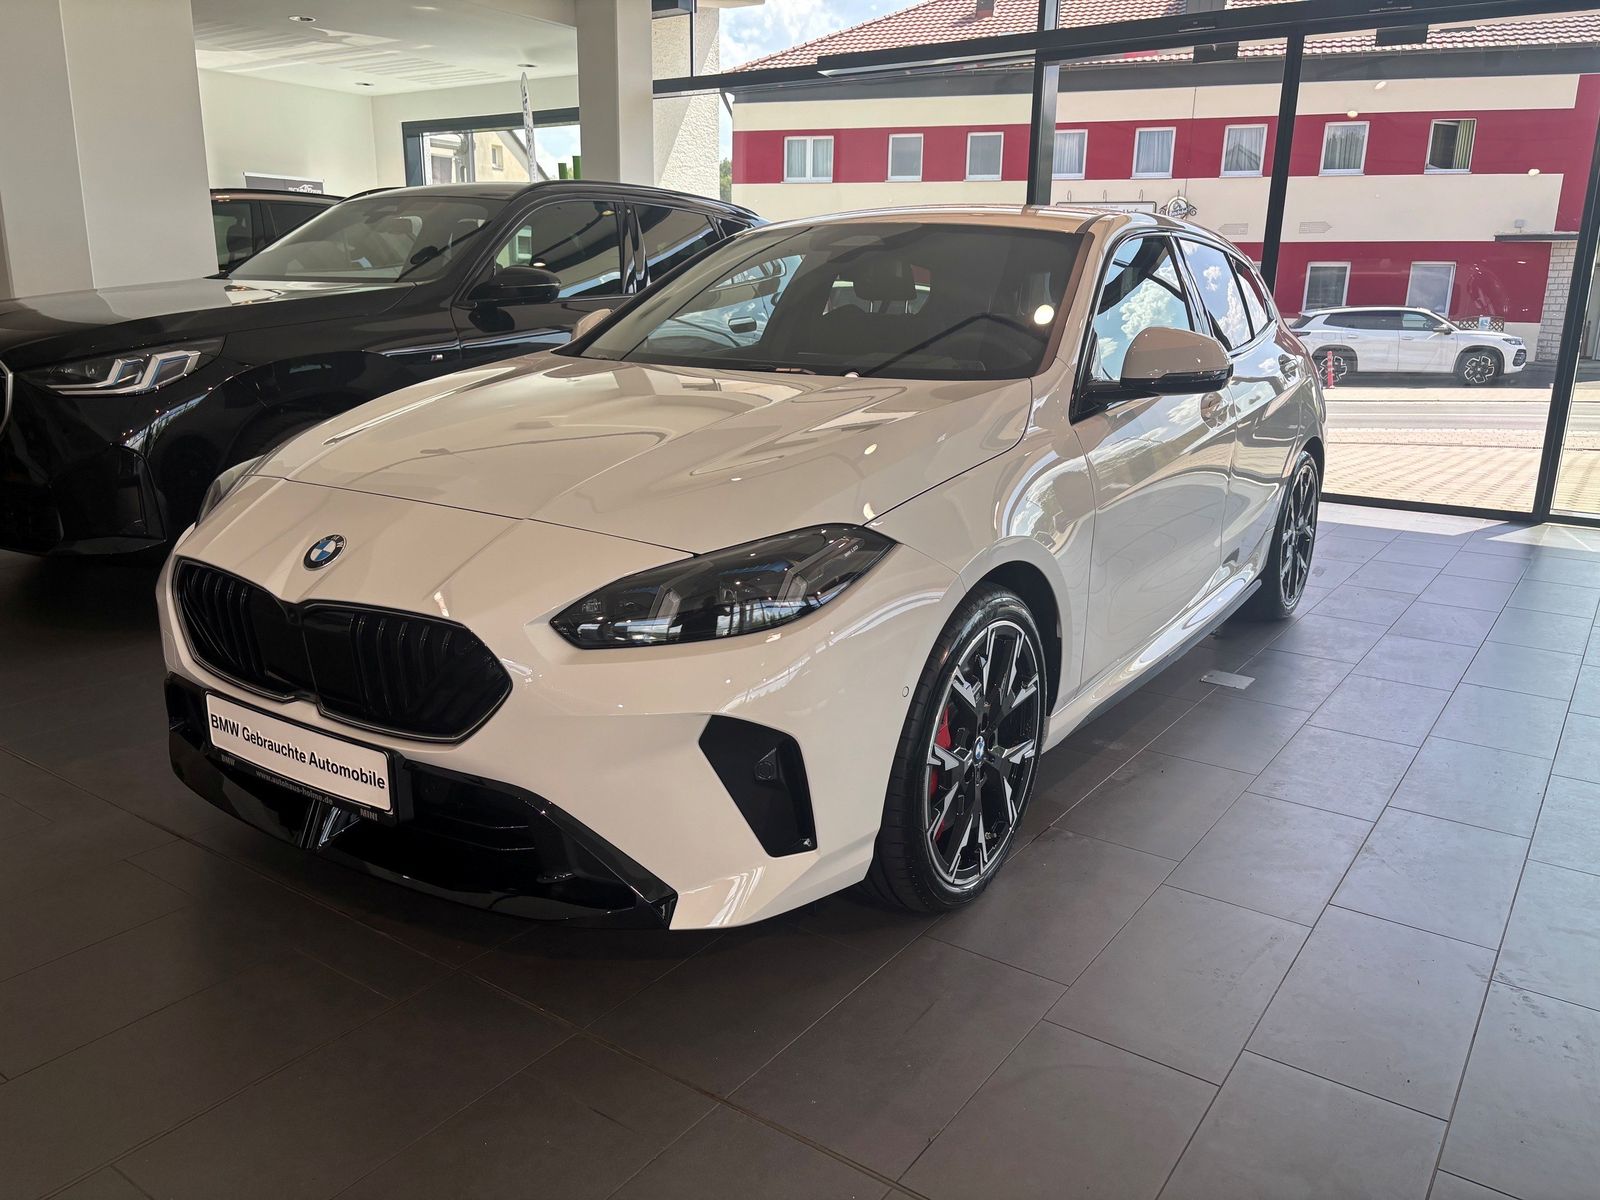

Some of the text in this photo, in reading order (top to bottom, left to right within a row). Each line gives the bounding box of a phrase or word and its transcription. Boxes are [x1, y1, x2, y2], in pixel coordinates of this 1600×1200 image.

[210, 713, 385, 789] BMW Gebrauchte Automobile
[220, 754, 236, 766] BMW
[360, 808, 378, 822] MINI
